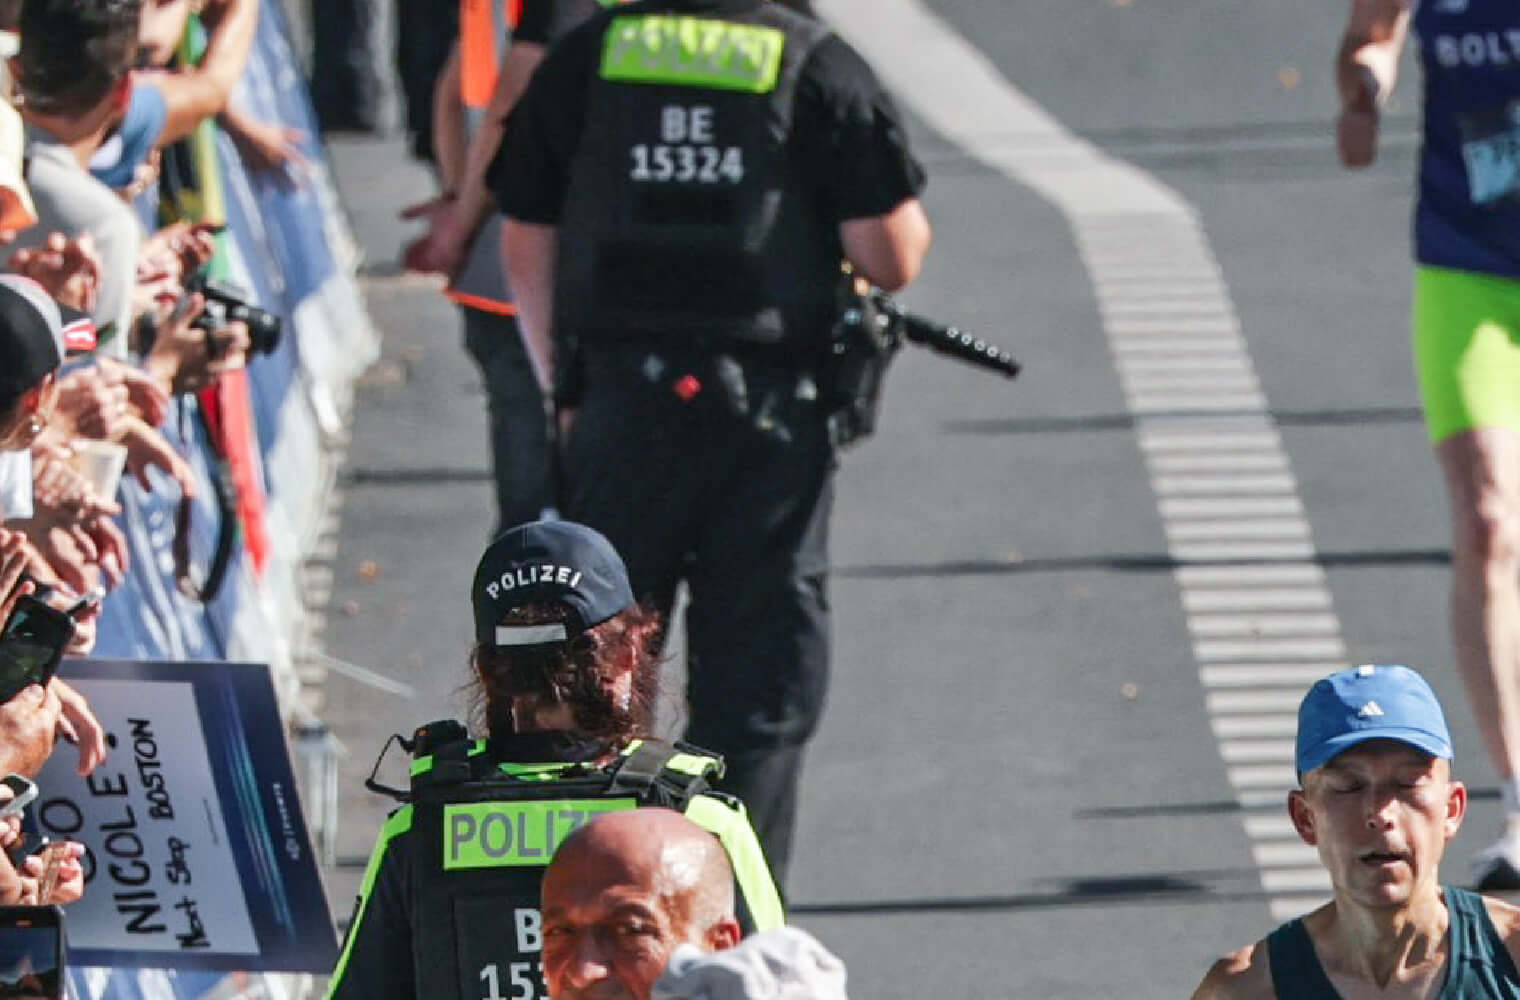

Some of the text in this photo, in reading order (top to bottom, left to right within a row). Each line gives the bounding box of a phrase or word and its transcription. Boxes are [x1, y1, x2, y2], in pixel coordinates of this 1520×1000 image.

[661, 105, 714, 142] BE
[629, 143, 744, 184] 15324
[486, 565, 582, 599] POLIZEI
[127, 717, 174, 820] BOSTON
[451, 810, 608, 861] POLI
